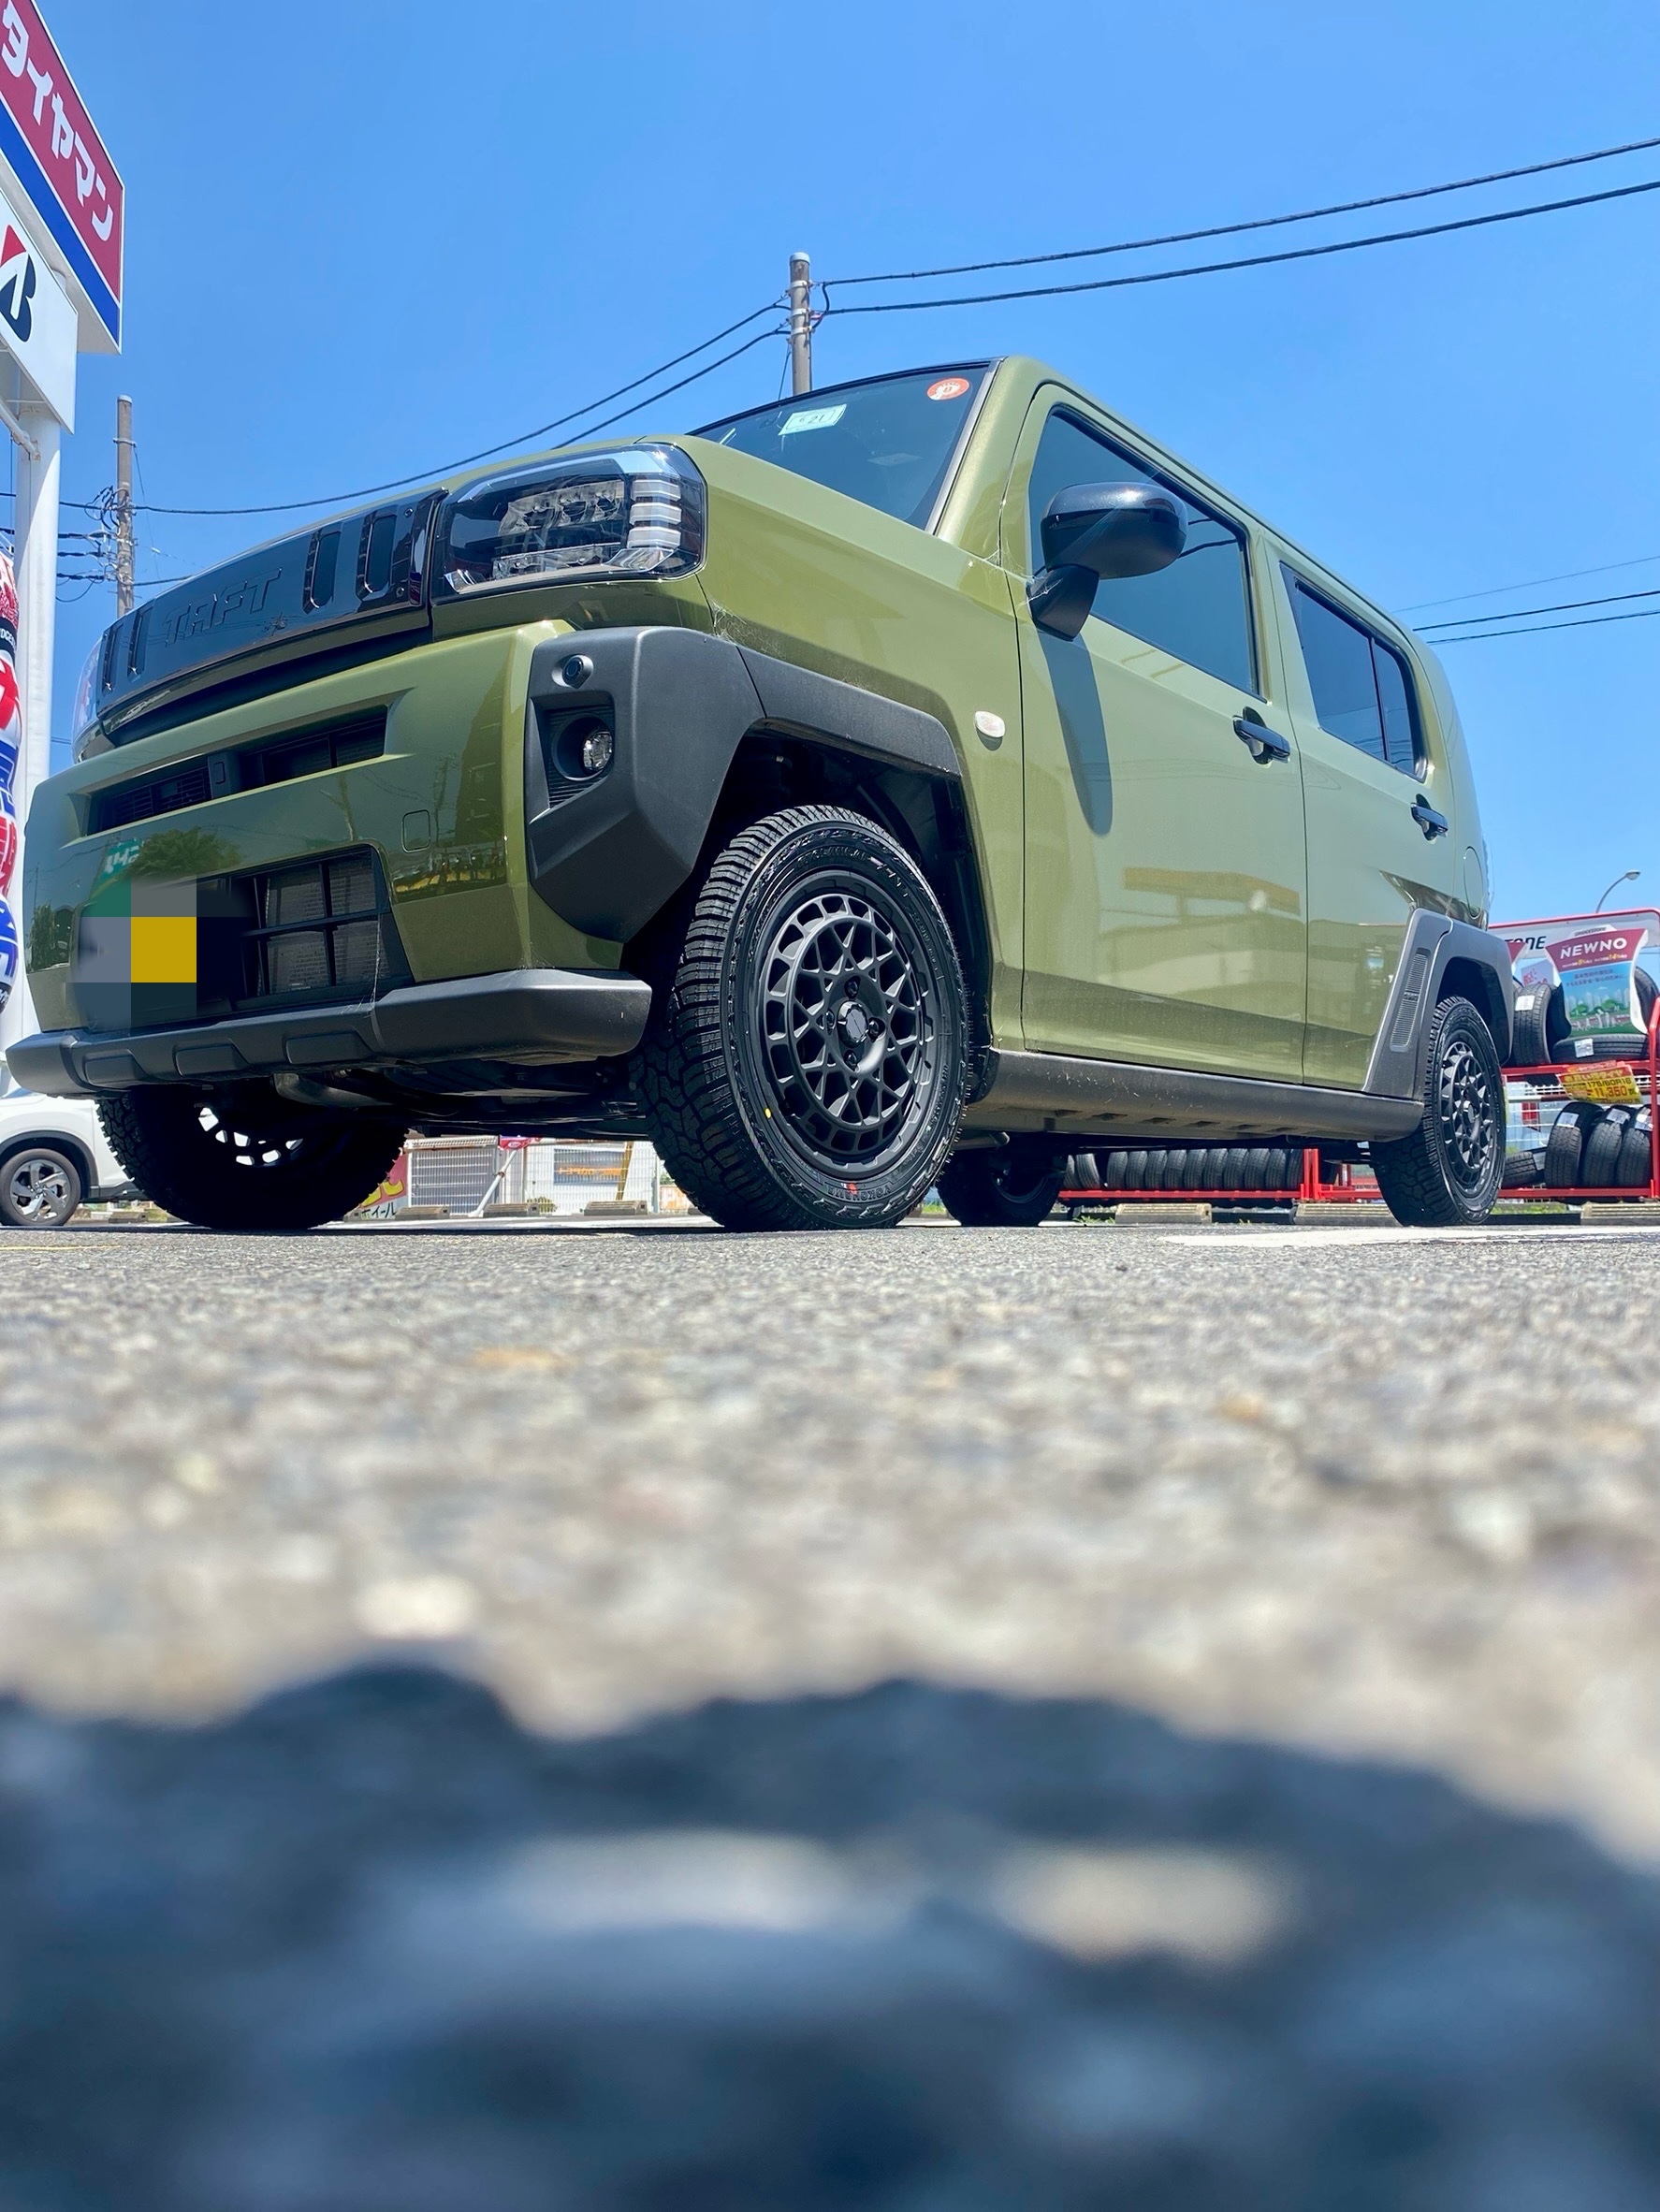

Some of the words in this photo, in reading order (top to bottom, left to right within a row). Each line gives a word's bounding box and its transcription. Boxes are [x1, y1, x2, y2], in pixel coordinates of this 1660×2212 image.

[163, 568, 283, 648] TAFT
[1560, 938, 1627, 959] NEWNO
[827, 1183, 892, 1201] YOKOHAMA
